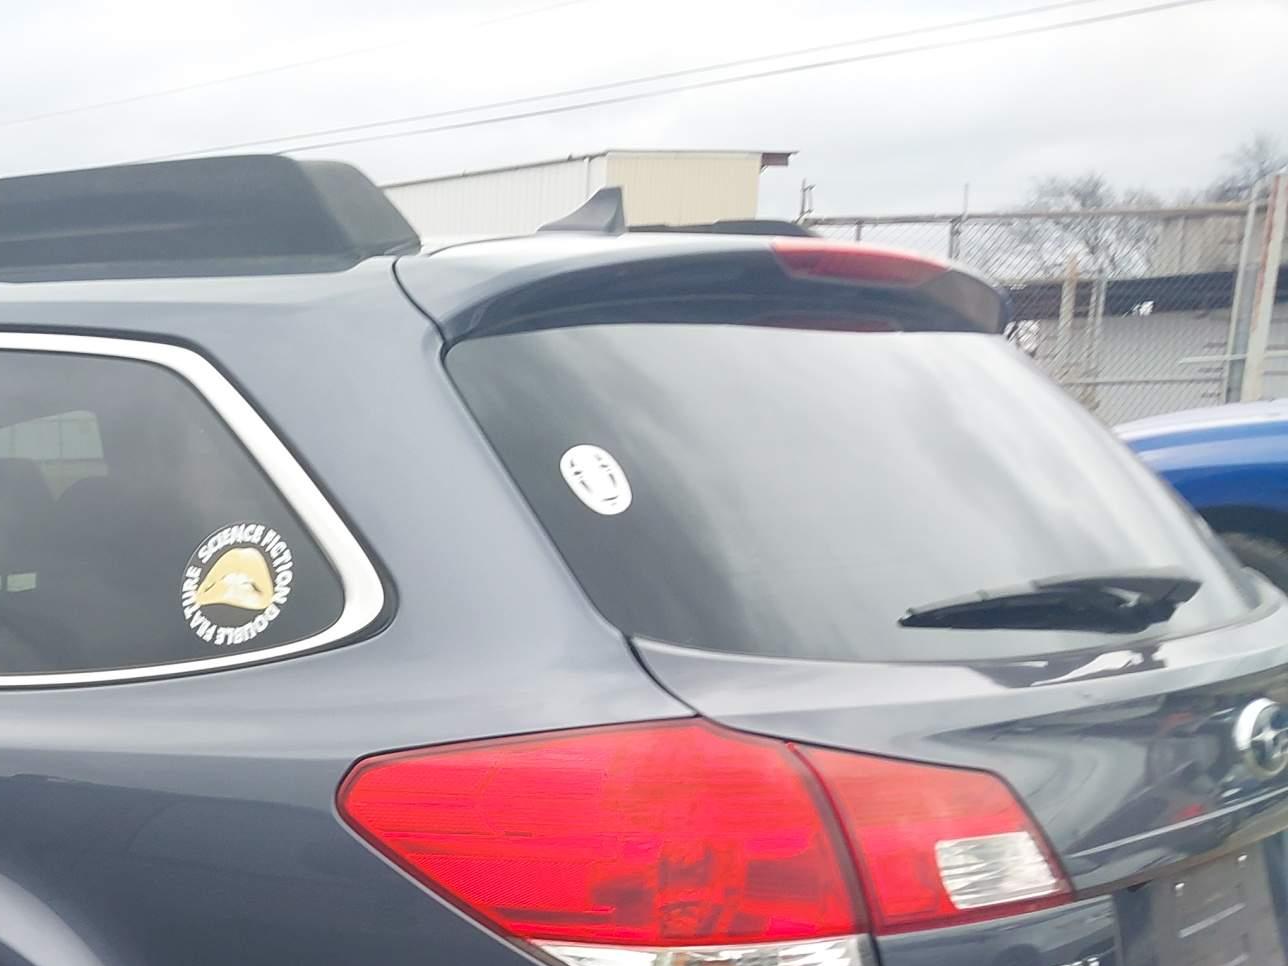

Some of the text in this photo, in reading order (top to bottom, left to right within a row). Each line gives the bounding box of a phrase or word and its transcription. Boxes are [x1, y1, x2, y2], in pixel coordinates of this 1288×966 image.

[198, 523, 265, 563] SCIENCE
[261, 529, 293, 604] FICTION
[214, 603, 280, 645] DOUBLE
